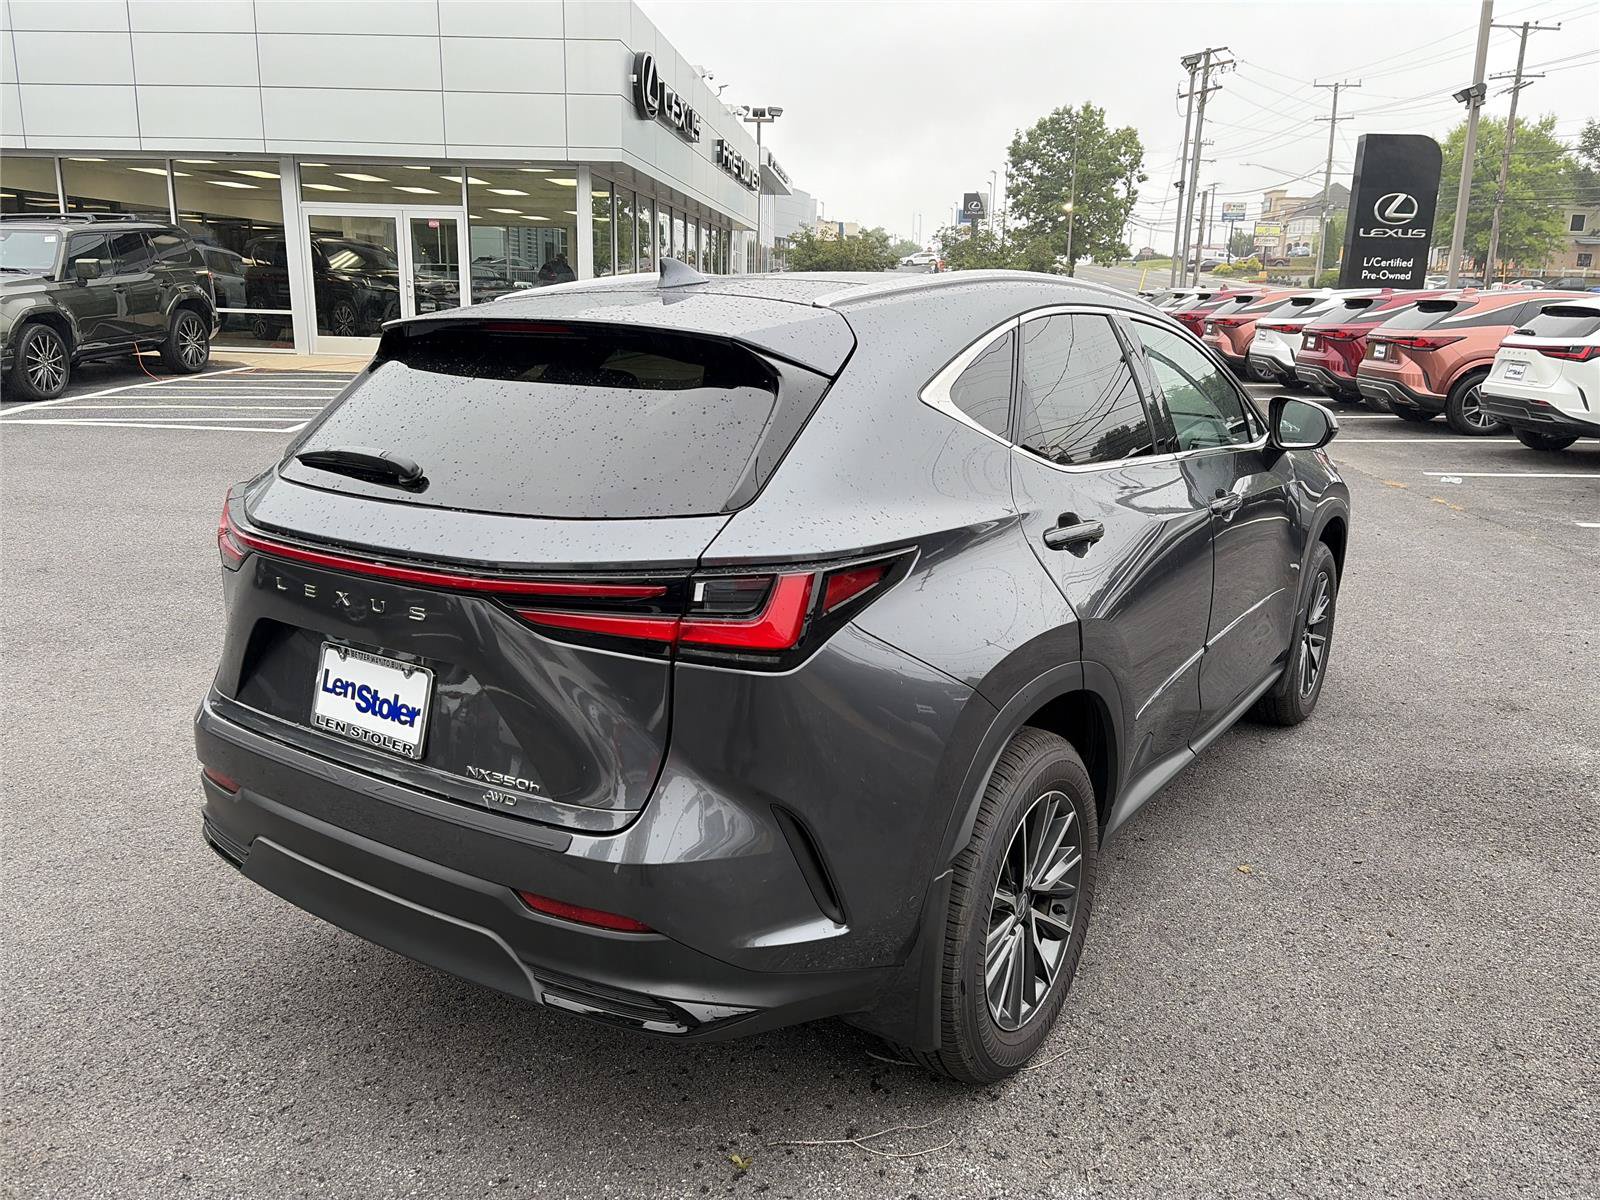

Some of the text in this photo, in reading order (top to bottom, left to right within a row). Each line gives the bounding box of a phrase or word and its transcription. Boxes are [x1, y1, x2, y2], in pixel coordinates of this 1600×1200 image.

[658, 81, 701, 142] LEXUS
[1359, 228, 1426, 238] LEXUS
[1363, 257, 1414, 267] L/Certified
[1361, 270, 1412, 280] Pre-Owned
[275, 576, 427, 622] LEXUS
[315, 715, 415, 756] LEN STOLER
[465, 765, 540, 792] NX350h
[482, 790, 517, 809] AWD
